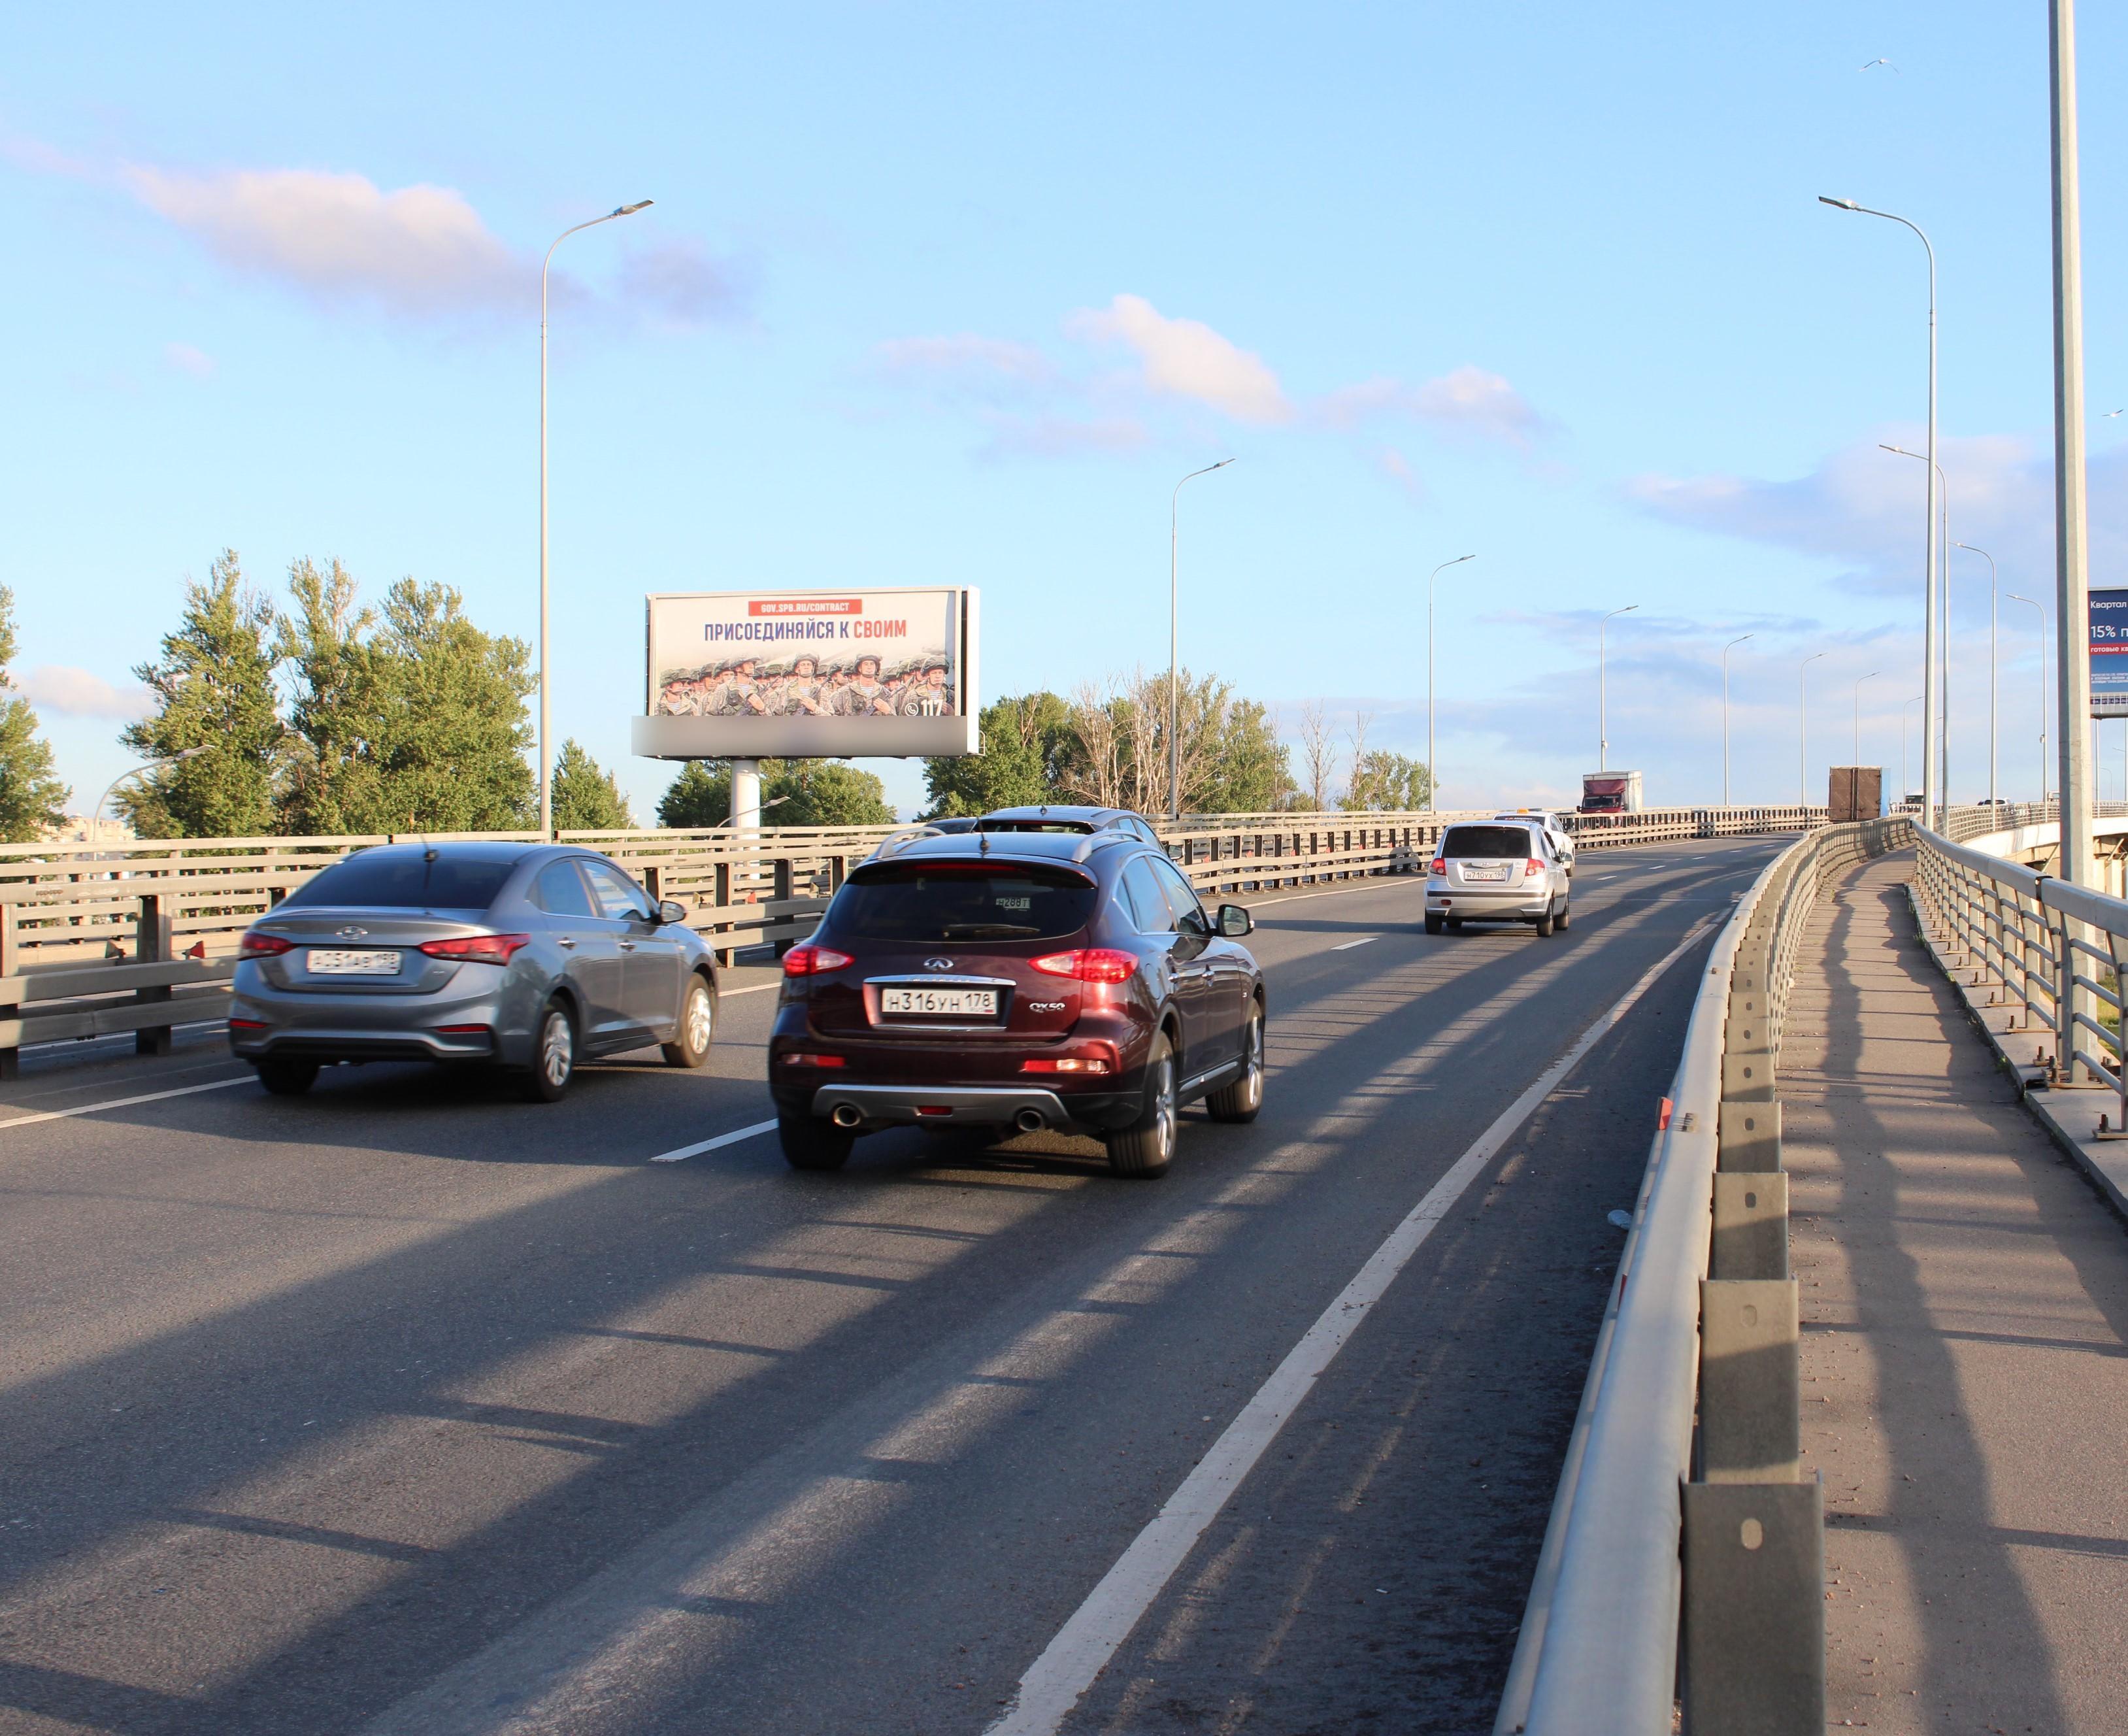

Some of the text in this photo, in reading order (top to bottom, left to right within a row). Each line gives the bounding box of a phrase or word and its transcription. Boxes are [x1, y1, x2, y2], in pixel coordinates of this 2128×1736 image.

[761, 602, 850, 613] GOV.SPB.RU/CONTRACT
[2090, 601, 2127, 610] Квартал
[705, 617, 906, 641] ПРИСОЕДИНЯЙСЯ К СВОИМ
[2090, 625, 2116, 638] 15%
[920, 699, 944, 716] 117
[889, 992, 991, 1011] Н316УН 178
[1029, 1003, 1065, 1012] QX50
